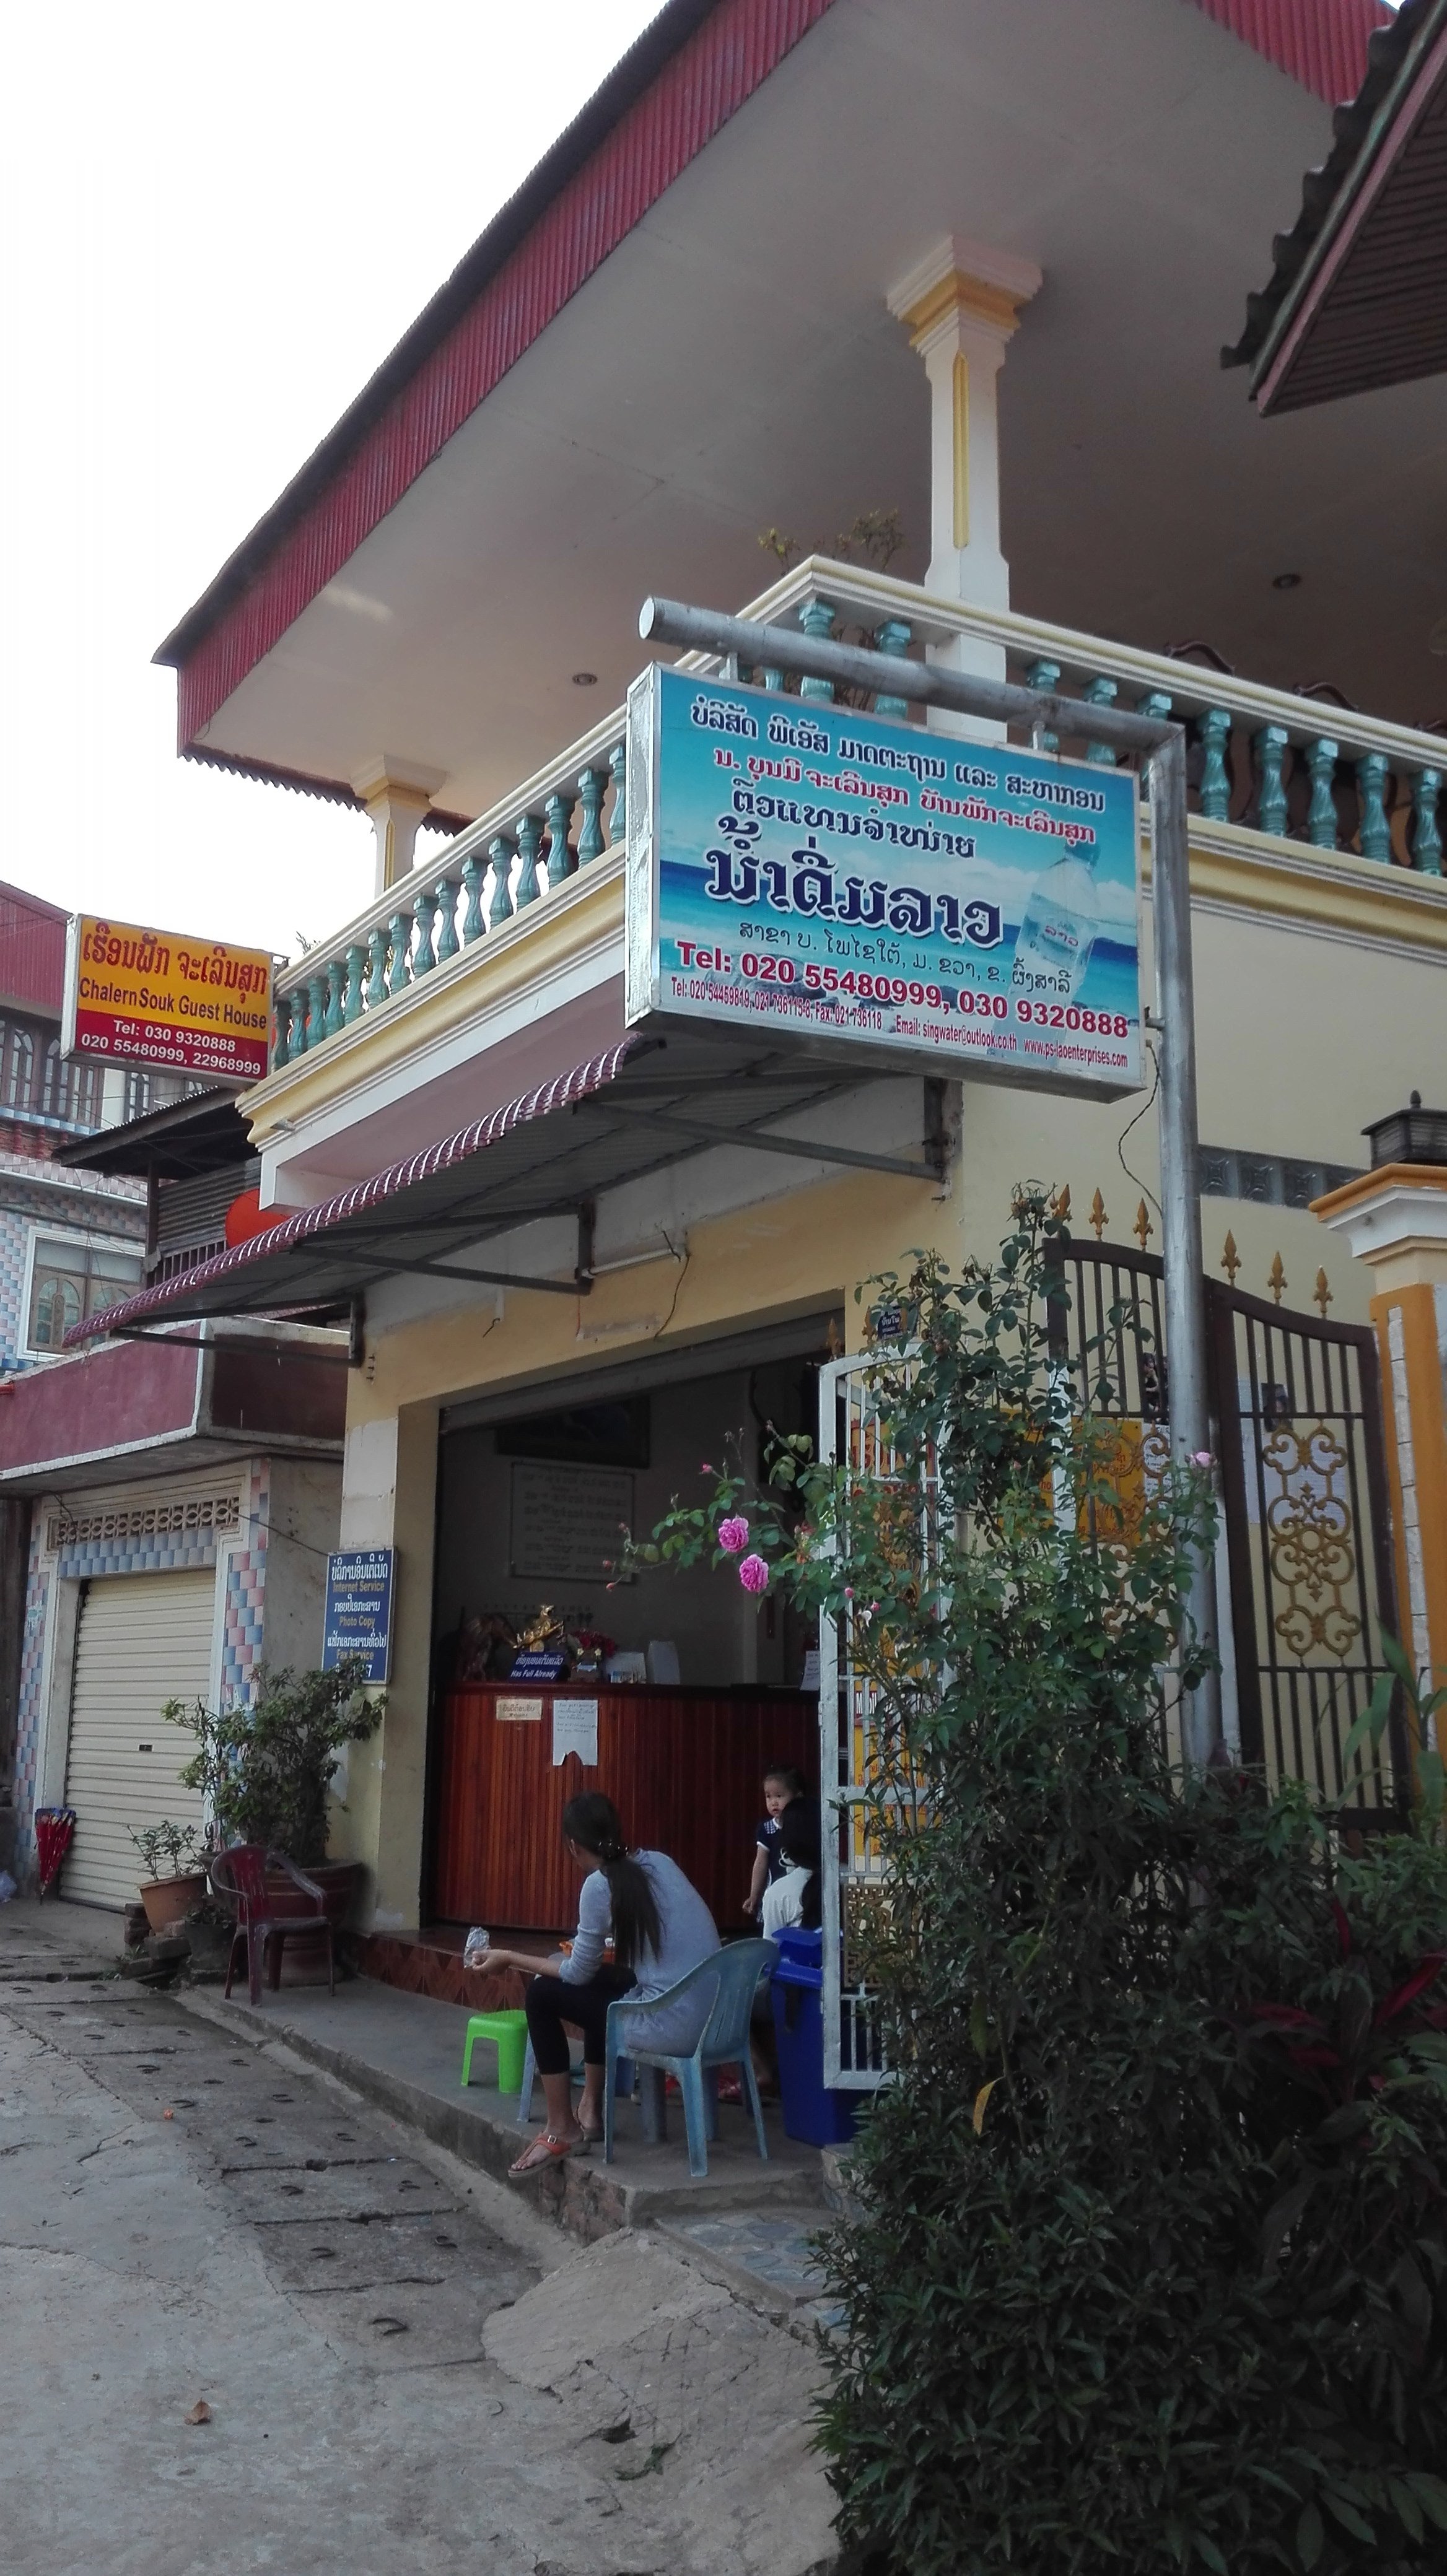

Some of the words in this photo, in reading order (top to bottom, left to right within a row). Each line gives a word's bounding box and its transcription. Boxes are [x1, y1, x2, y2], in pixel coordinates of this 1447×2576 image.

[838, 738, 946, 782] ມາດຕະຖານ
[955, 764, 997, 788] ແລະ
[1006, 775, 1104, 812] ສະຫາກອນ
[739, 921, 790, 946] ສາຂາ
[913, 953, 932, 970] ມ.
[140, 987, 175, 1013] Souk
[178, 995, 220, 1021] Guest
[224, 1004, 267, 1030] House
[676, 940, 732, 973] Tel:
[741, 952, 795, 984] 020
[805, 964, 950, 1015] 55480999,
[959, 990, 1008, 1019] 030
[1016, 1000, 1129, 1038] 9320888
[671, 977, 688, 998] Tel:
[690, 979, 706, 1001] 020
[815, 1001, 833, 1022] Fax:
[896, 1014, 921, 1036] Email:
[923, 1019, 1018, 1051] singwater@outlook.co.th
[81, 1033, 109, 1050] 020
[113, 1039, 188, 1064] 55480999,
[193, 1052, 261, 1075] 22968999
[113, 1019, 140, 1036] Tel:
[144, 1025, 172, 1041] 030
[175, 1030, 237, 1053] 9320888
[333, 1582, 359, 1593] Internet
[359, 1580, 385, 1593] Service
[338, 1616, 357, 1627] Photo
[359, 1615, 375, 1629] Copy
[336, 1648, 348, 1660] Fax
[510, 1669, 522, 1677] Has
[522, 1669, 534, 1677] Full
[533, 1669, 557, 1679] Already
